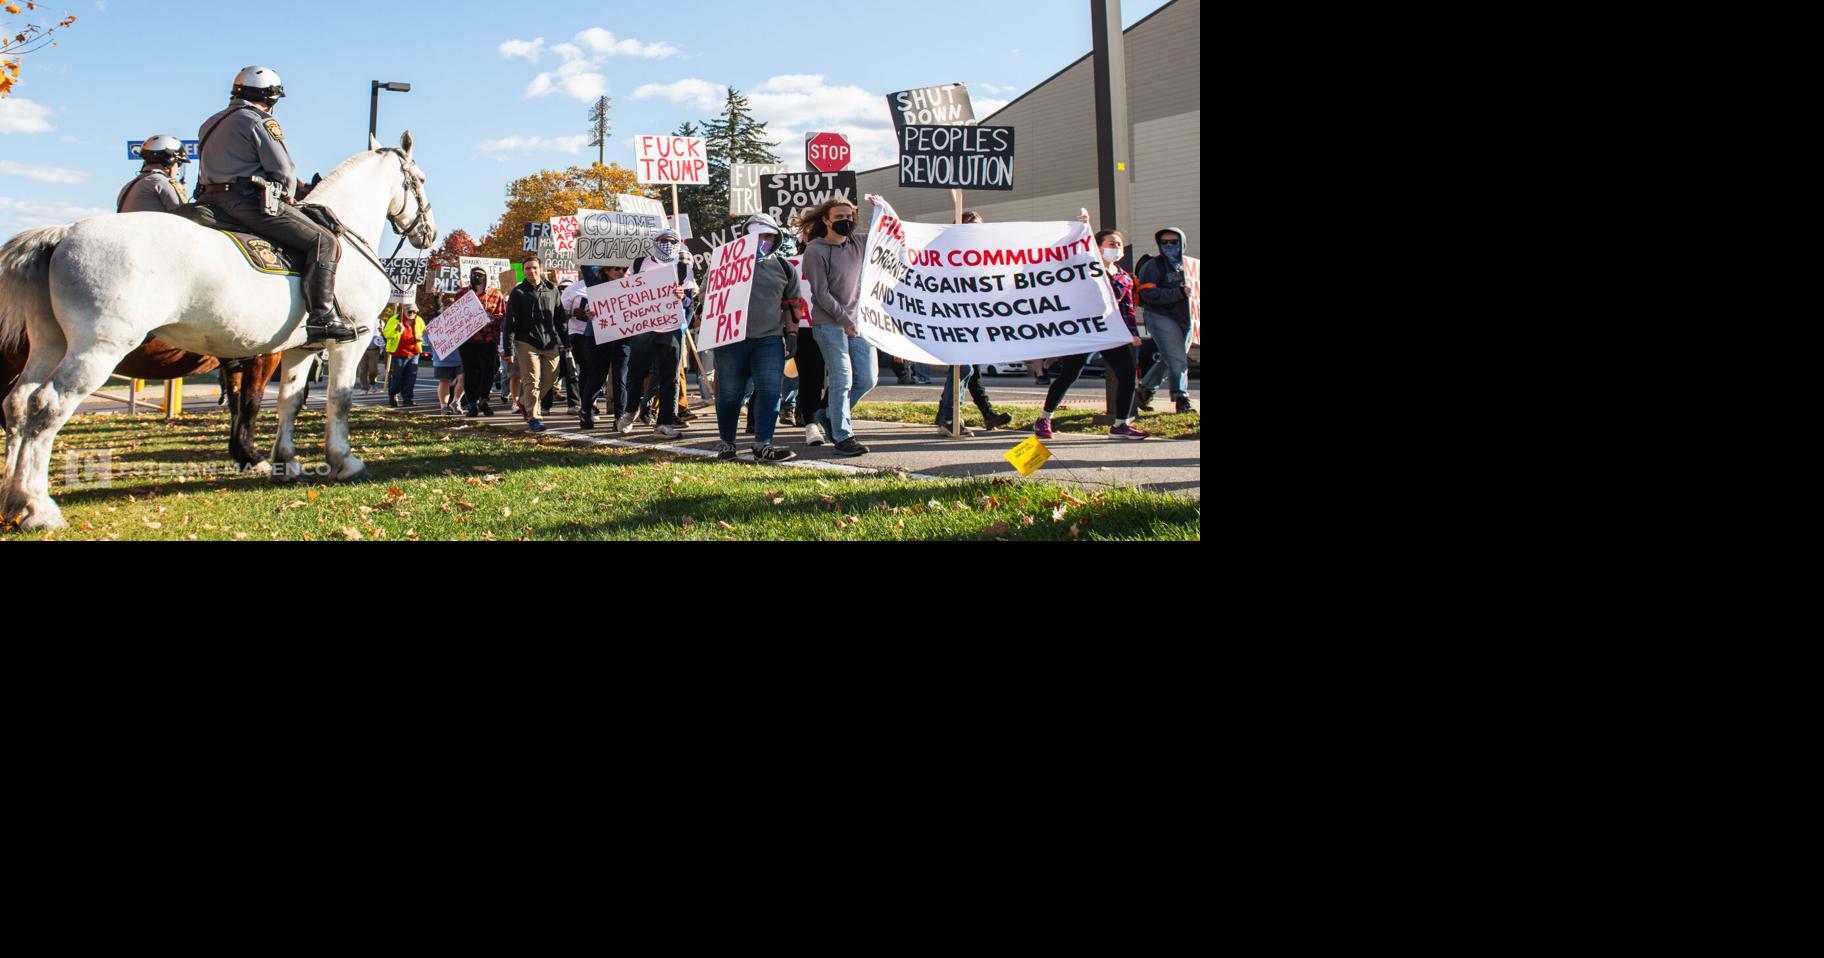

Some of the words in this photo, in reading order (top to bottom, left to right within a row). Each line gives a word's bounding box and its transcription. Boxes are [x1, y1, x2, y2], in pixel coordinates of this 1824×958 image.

[897, 85, 955, 111] SHUT
[903, 104, 961, 125] DOWN
[642, 136, 700, 157] FUCK
[905, 127, 1009, 152] PEOPLES
[811, 144, 848, 160] STOP
[640, 158, 704, 182] TRUMP
[768, 172, 838, 191] SHUT
[901, 155, 1013, 186] REVOLUTION
[732, 187, 762, 213] TRU
[777, 187, 850, 206] DOWN
[531, 222, 551, 237] FR
[559, 215, 577, 224] MA
[584, 213, 611, 237] GO
[616, 213, 656, 237] HOME
[577, 237, 656, 261] DICTATOR
[720, 238, 746, 266] NO
[908, 248, 943, 267] OUR
[947, 235, 1091, 268] COMMUNITY
[380, 258, 428, 268] RACISTS
[440, 266, 460, 279] FR
[545, 259, 576, 269] AGAIN
[707, 254, 755, 294] FASCISTS
[391, 275, 426, 286] MPUS
[620, 276, 646, 289] U.S.
[914, 274, 1005, 293] AGAINST
[1014, 261, 1104, 289] BIGOTS
[592, 282, 679, 318] IMPERIALISM
[706, 289, 731, 320] IN
[871, 281, 894, 306] AND
[897, 293, 926, 316] THE
[931, 295, 1070, 318] ANTISOCIAL
[598, 315, 617, 330] #1
[623, 303, 661, 323] ENEMY
[666, 300, 679, 310] OF
[619, 314, 679, 336] WORKERS
[716, 310, 742, 344] PA!
[923, 325, 979, 343] THEY
[986, 316, 1108, 342] PROMOTE
